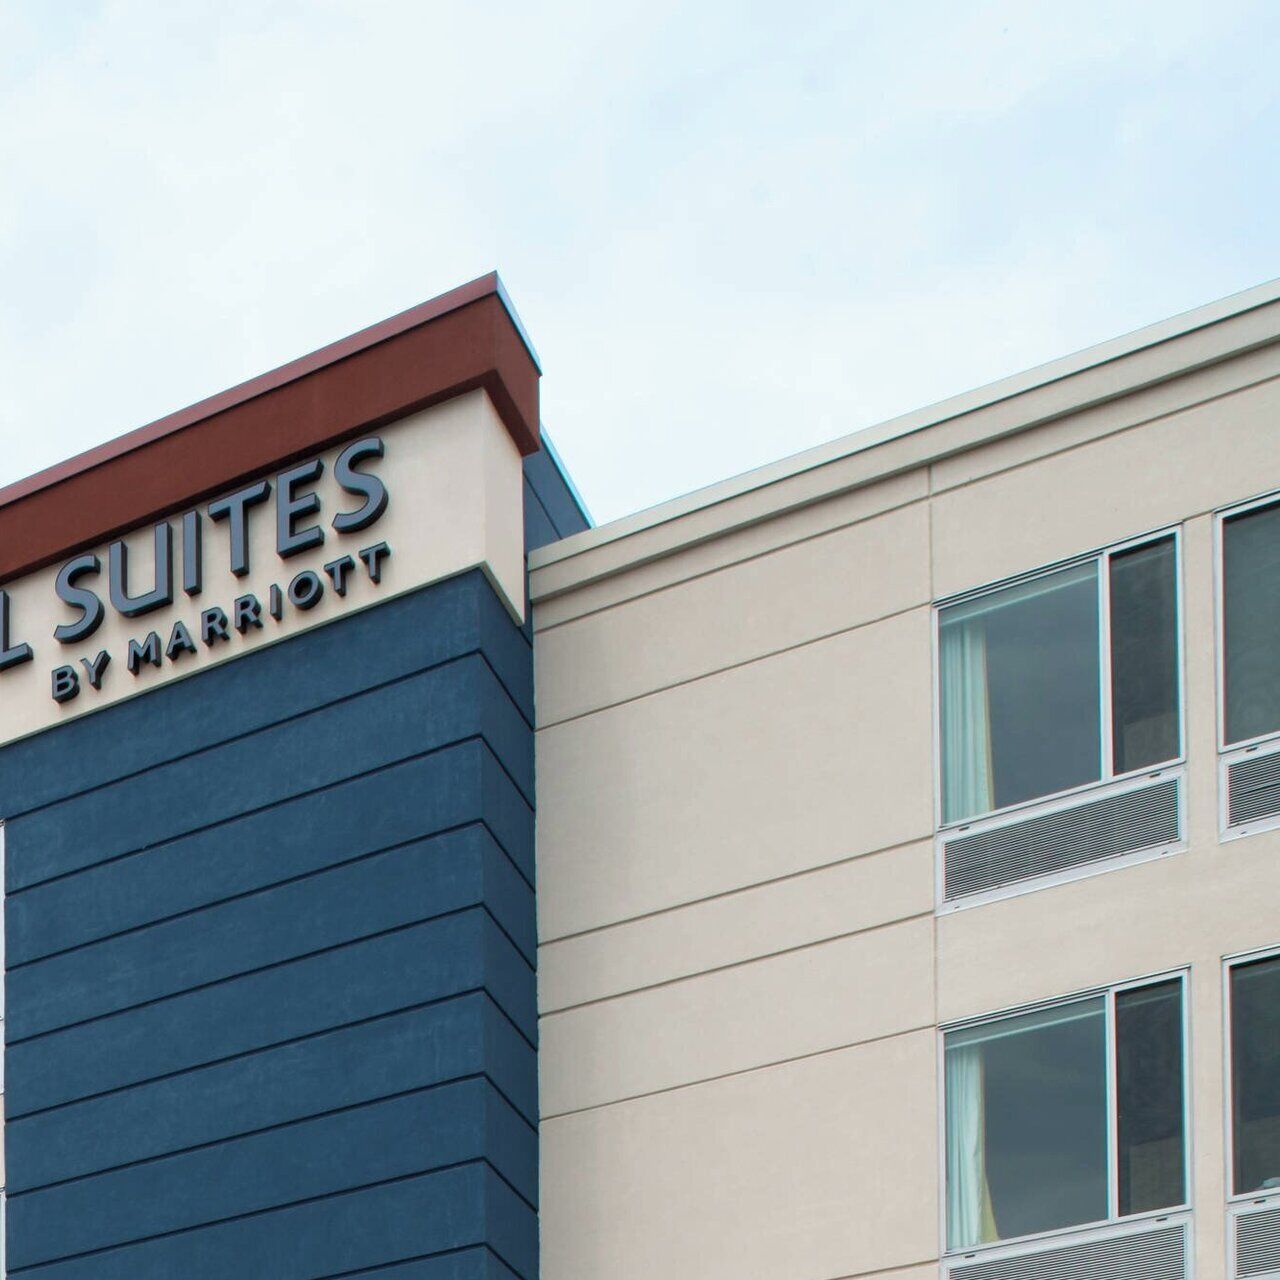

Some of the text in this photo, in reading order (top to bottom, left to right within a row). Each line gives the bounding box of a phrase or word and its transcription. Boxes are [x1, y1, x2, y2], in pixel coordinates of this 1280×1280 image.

[51, 542, 391, 703] BY MARRIOTT
[53, 438, 389, 644] SUITES
